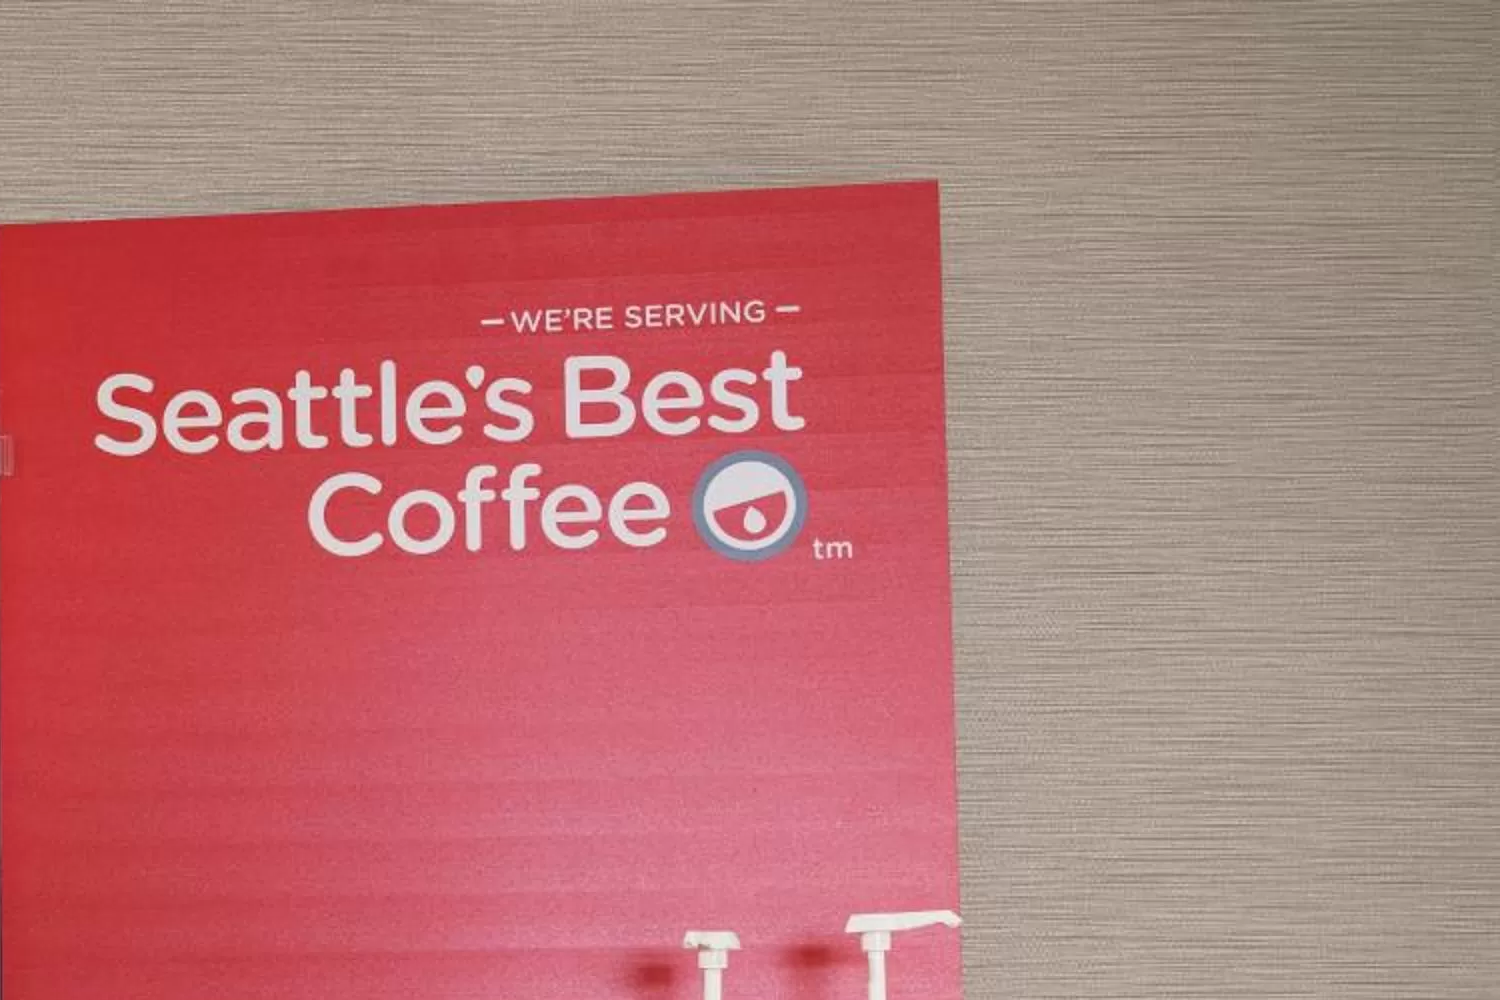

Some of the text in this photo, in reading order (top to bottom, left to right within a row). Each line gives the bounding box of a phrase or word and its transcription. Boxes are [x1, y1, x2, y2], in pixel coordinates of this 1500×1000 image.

[510, 300, 766, 334] WE'RE SERVING
[94, 350, 805, 457] Seattle's Best
[307, 463, 671, 558] Coffee
[812, 537, 854, 560] tm
